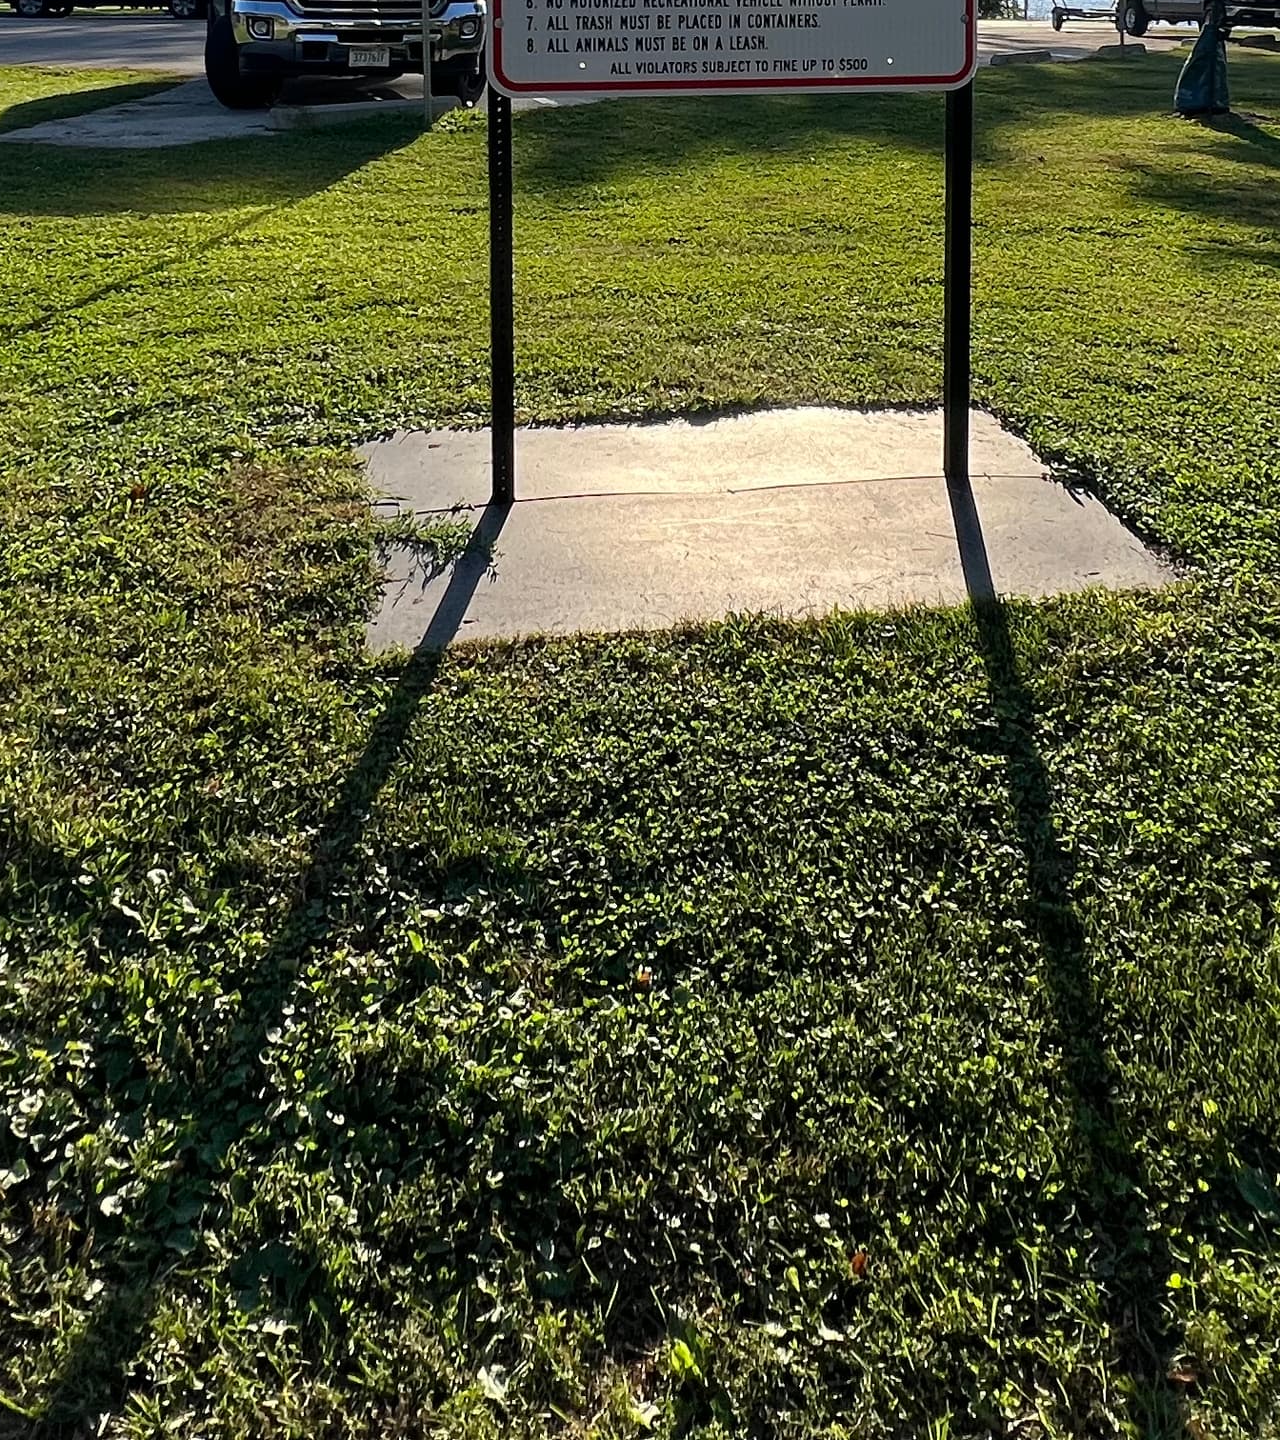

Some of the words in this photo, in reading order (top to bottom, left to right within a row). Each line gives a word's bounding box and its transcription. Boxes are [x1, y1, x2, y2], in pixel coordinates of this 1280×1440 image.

[527, 16, 537, 31] 7.
[547, 16, 569, 30] ALL
[576, 15, 612, 30] TRASH
[620, 15, 650, 29] MUST
[657, 15, 671, 29] BE
[678, 14, 721, 29] PLACED
[729, 14, 740, 29] IN
[748, 14, 820, 28] CONTAINERS.
[527, 38, 537, 53] 8.
[547, 38, 569, 52] ALL
[576, 37, 628, 52] ANIMALS
[636, 37, 665, 51] MUST
[672, 37, 686, 51] BE
[693, 36, 708, 50] ON
[715, 36, 723, 50] A
[730, 36, 768, 50] LEASH.
[611, 62, 631, 74] ALL
[636, 62, 697, 74] VIOLATORS
[702, 61, 751, 73] SUBJECT
[755, 60, 768, 72] TO
[773, 60, 798, 71] FINE
[803, 60, 817, 71] UP
[822, 59, 834, 70] TO
[839, 58, 867, 71] $500
